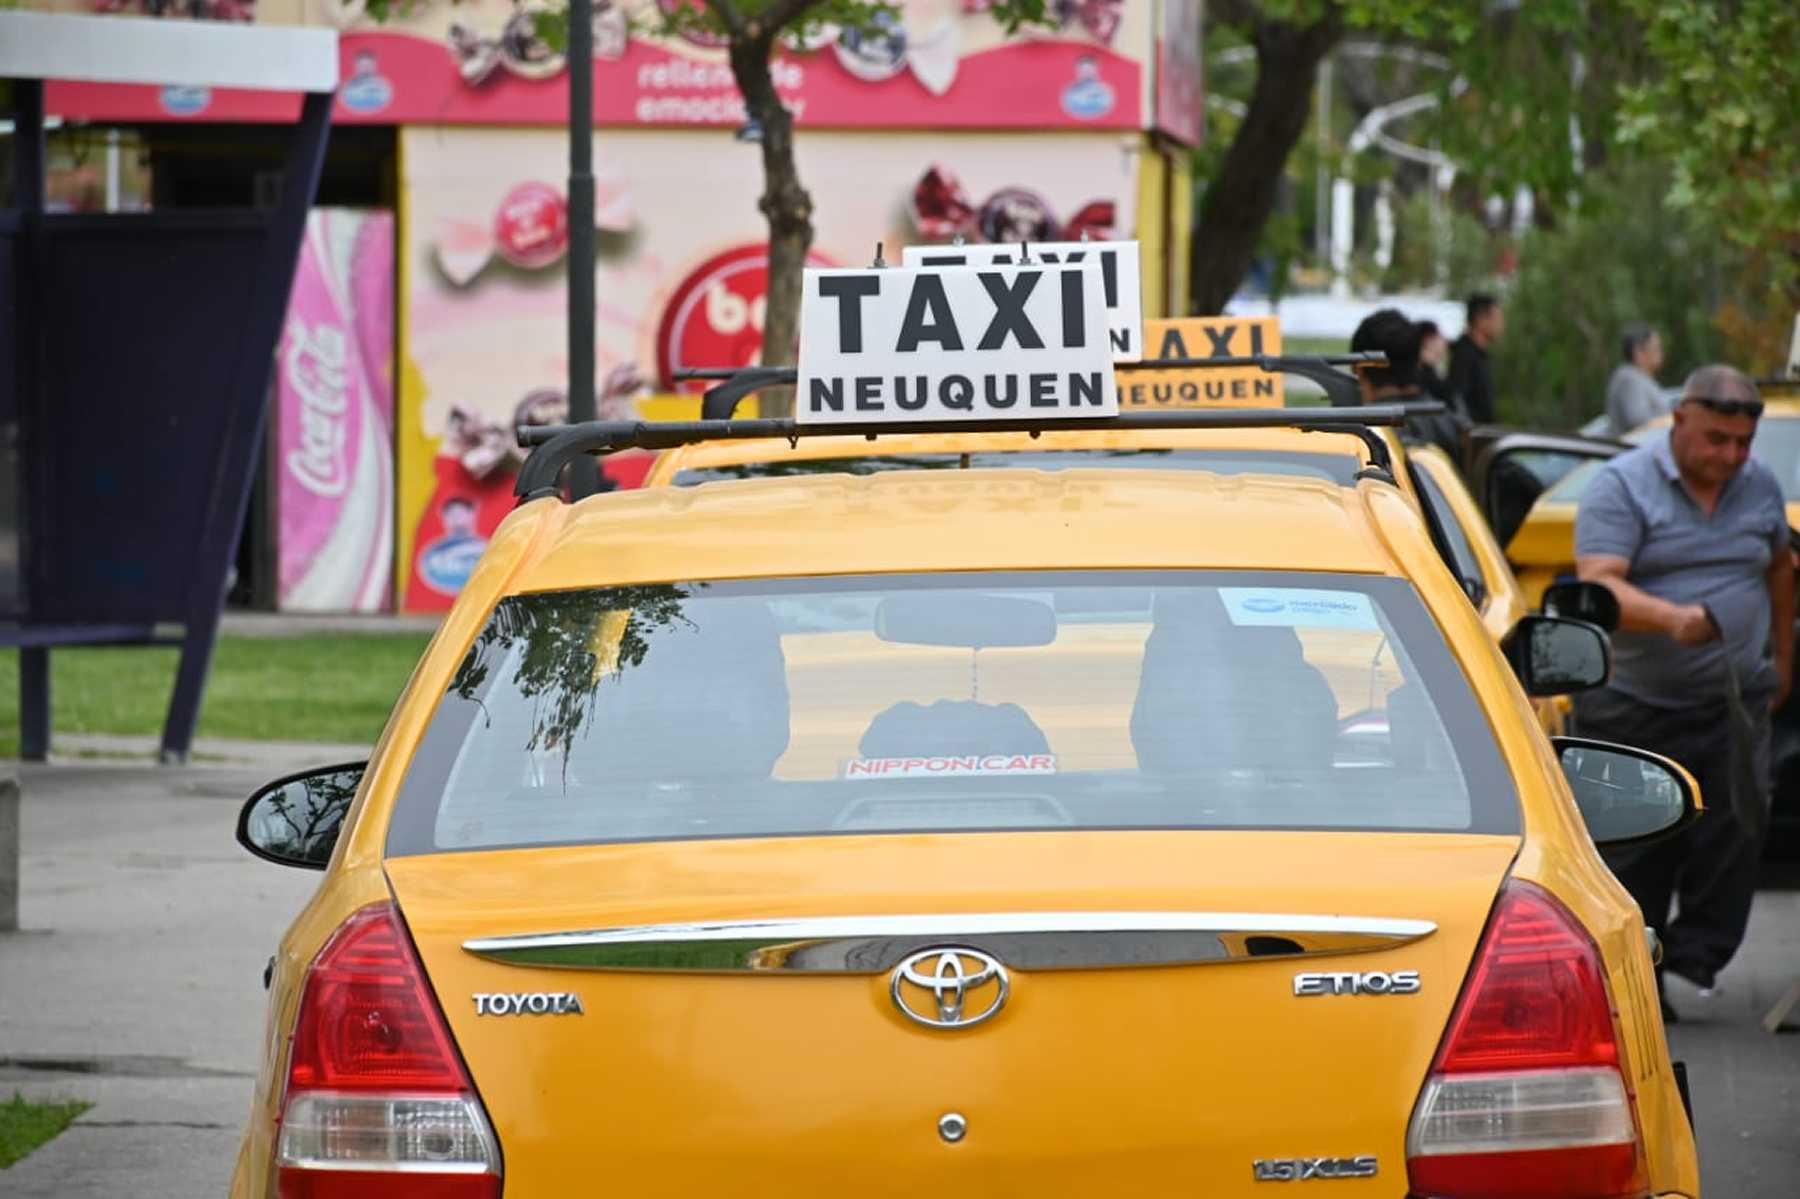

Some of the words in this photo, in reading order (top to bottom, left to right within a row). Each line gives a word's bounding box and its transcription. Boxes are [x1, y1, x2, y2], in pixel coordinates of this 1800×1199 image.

[818, 269, 1086, 354] TAXI
[1159, 325, 1264, 361] AXI
[809, 372, 1104, 412] NEUQUEN
[849, 757, 977, 775] NIPPON
[982, 754, 1053, 771] CAR
[1293, 971, 1420, 996] ETIOS
[471, 992, 585, 1017] TOYOTA
